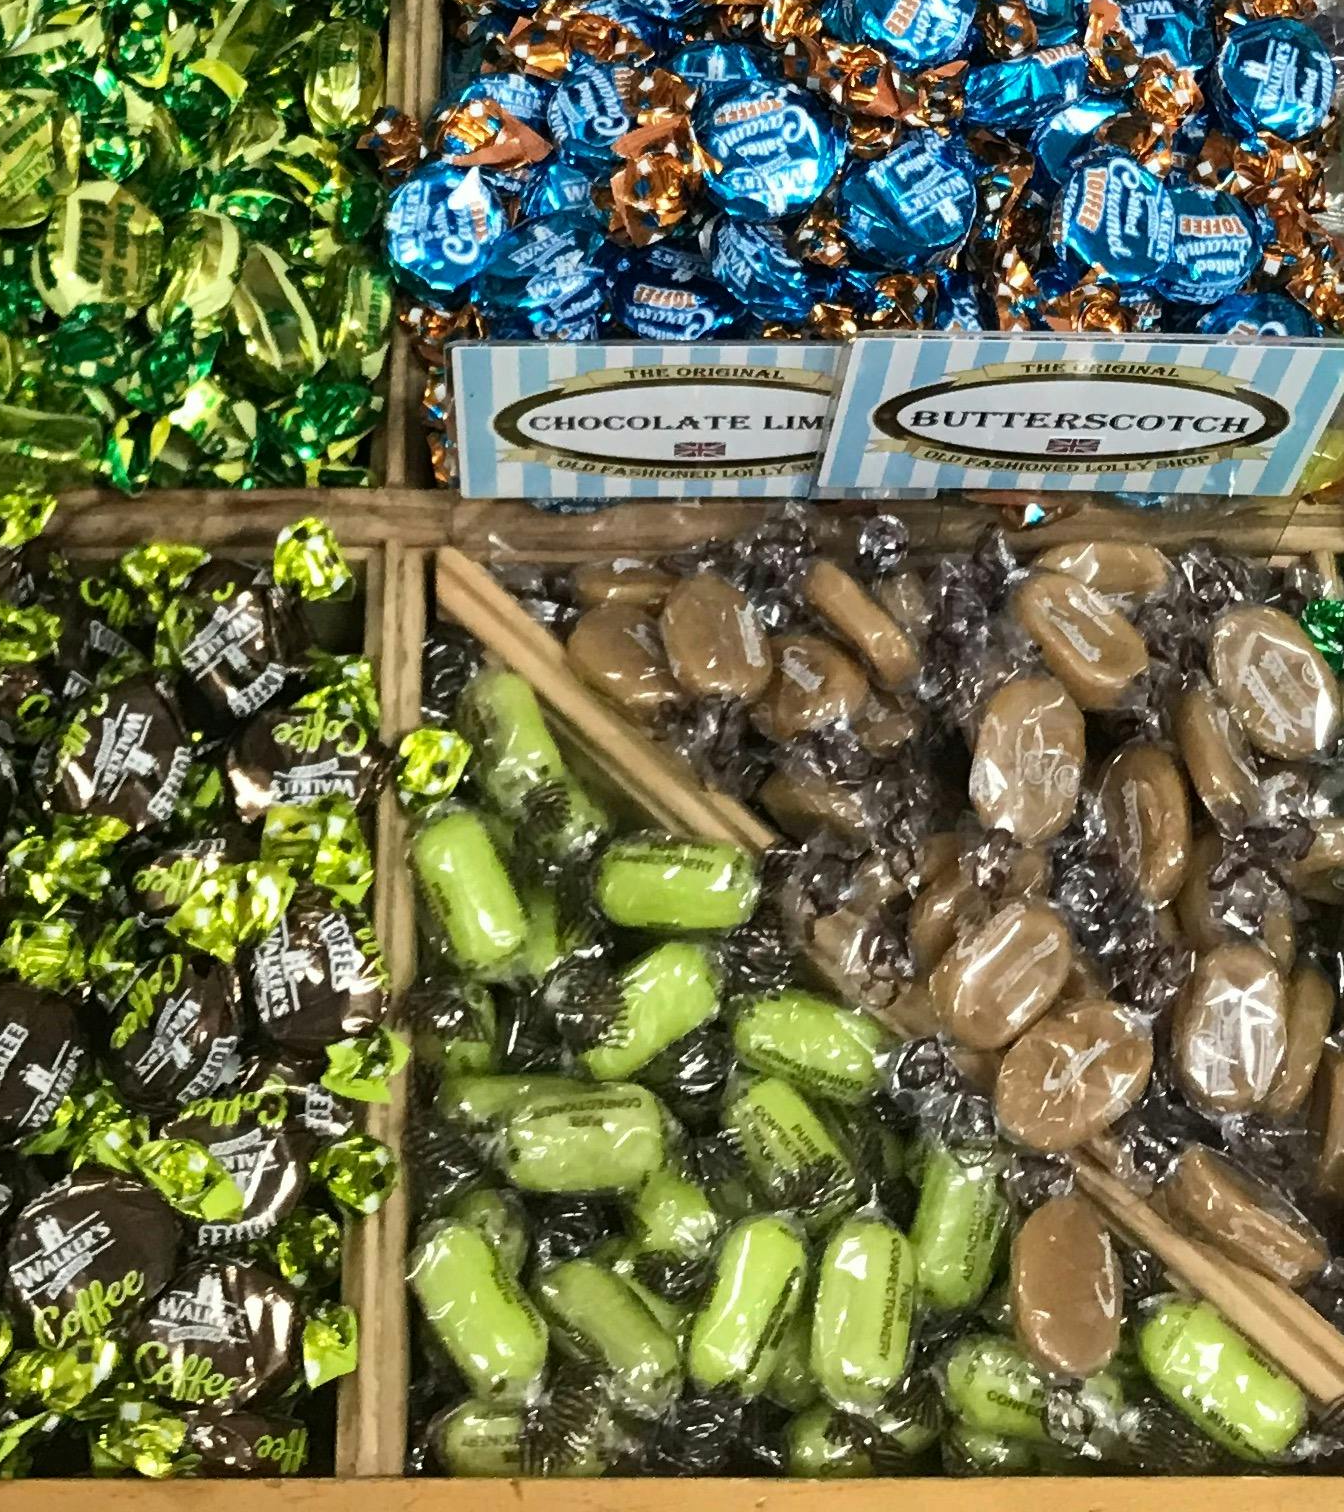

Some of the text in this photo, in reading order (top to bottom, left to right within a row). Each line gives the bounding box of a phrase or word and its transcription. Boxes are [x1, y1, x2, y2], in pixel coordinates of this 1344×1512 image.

[1257, 40, 1292, 111] WALKER'S
[1078, 167, 1109, 234] TOFFEE
[1180, 214, 1247, 236] TOFFEE
[624, 367, 785, 380] THE ORIGINAL
[1020, 363, 1180, 377] THE ORIGINAL
[528, 414, 834, 431] CHOCOLATE LIM
[910, 410, 1250, 433] BUTTERSCOTCH
[557, 459, 593, 471] OLD
[596, 465, 717, 479] FASHIONED
[721, 464, 787, 479] LOLLY
[923, 449, 1211, 473] OLD FASHIONED LOLLY SHOP
[271, 708, 367, 756] Coffee
[11, 1221, 113, 1291] WALKER'S
[32, 1270, 145, 1351] Coffee
[878, 1236, 902, 1361] CONFECTIONERY
